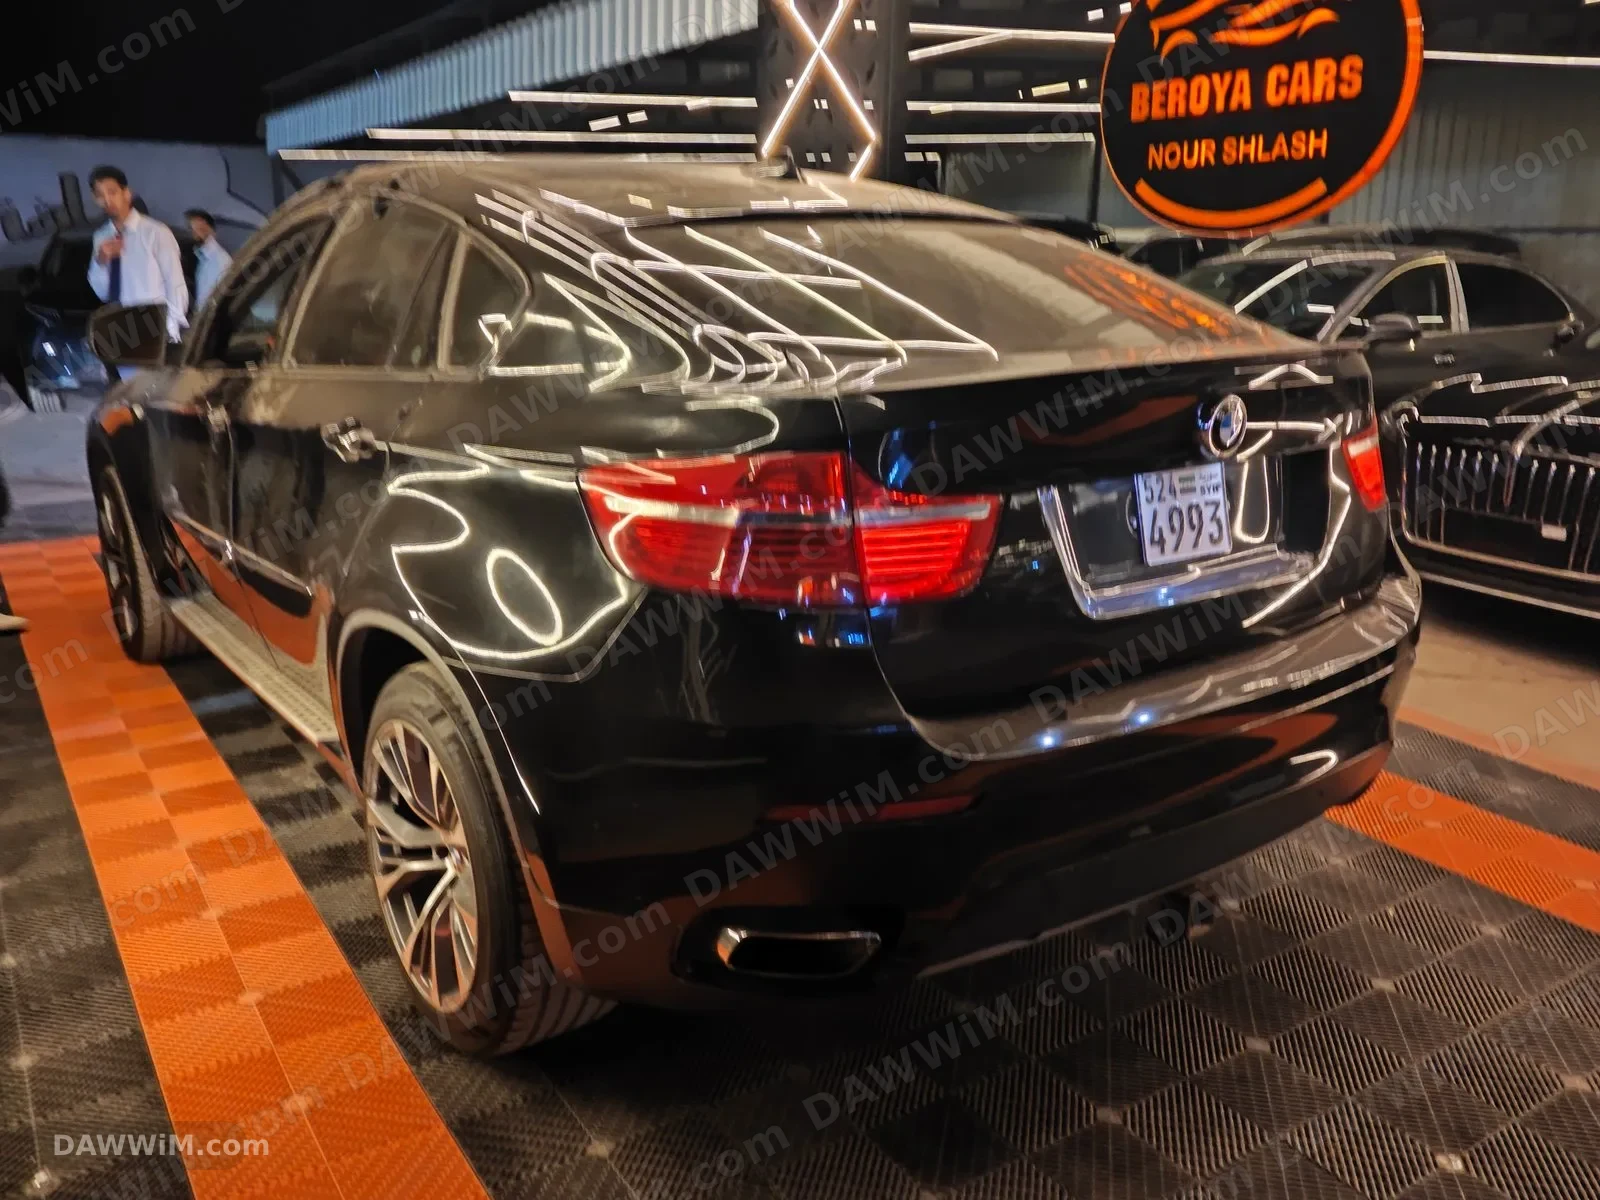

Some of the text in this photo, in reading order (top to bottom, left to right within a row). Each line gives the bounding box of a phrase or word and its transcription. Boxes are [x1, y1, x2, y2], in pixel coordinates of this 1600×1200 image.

[1131, 54, 1364, 124] BEROYA CARS
[1148, 128, 1328, 171] NOUR SHLASH
[1143, 473, 1177, 504] 524
[1150, 501, 1224, 555] 4993
